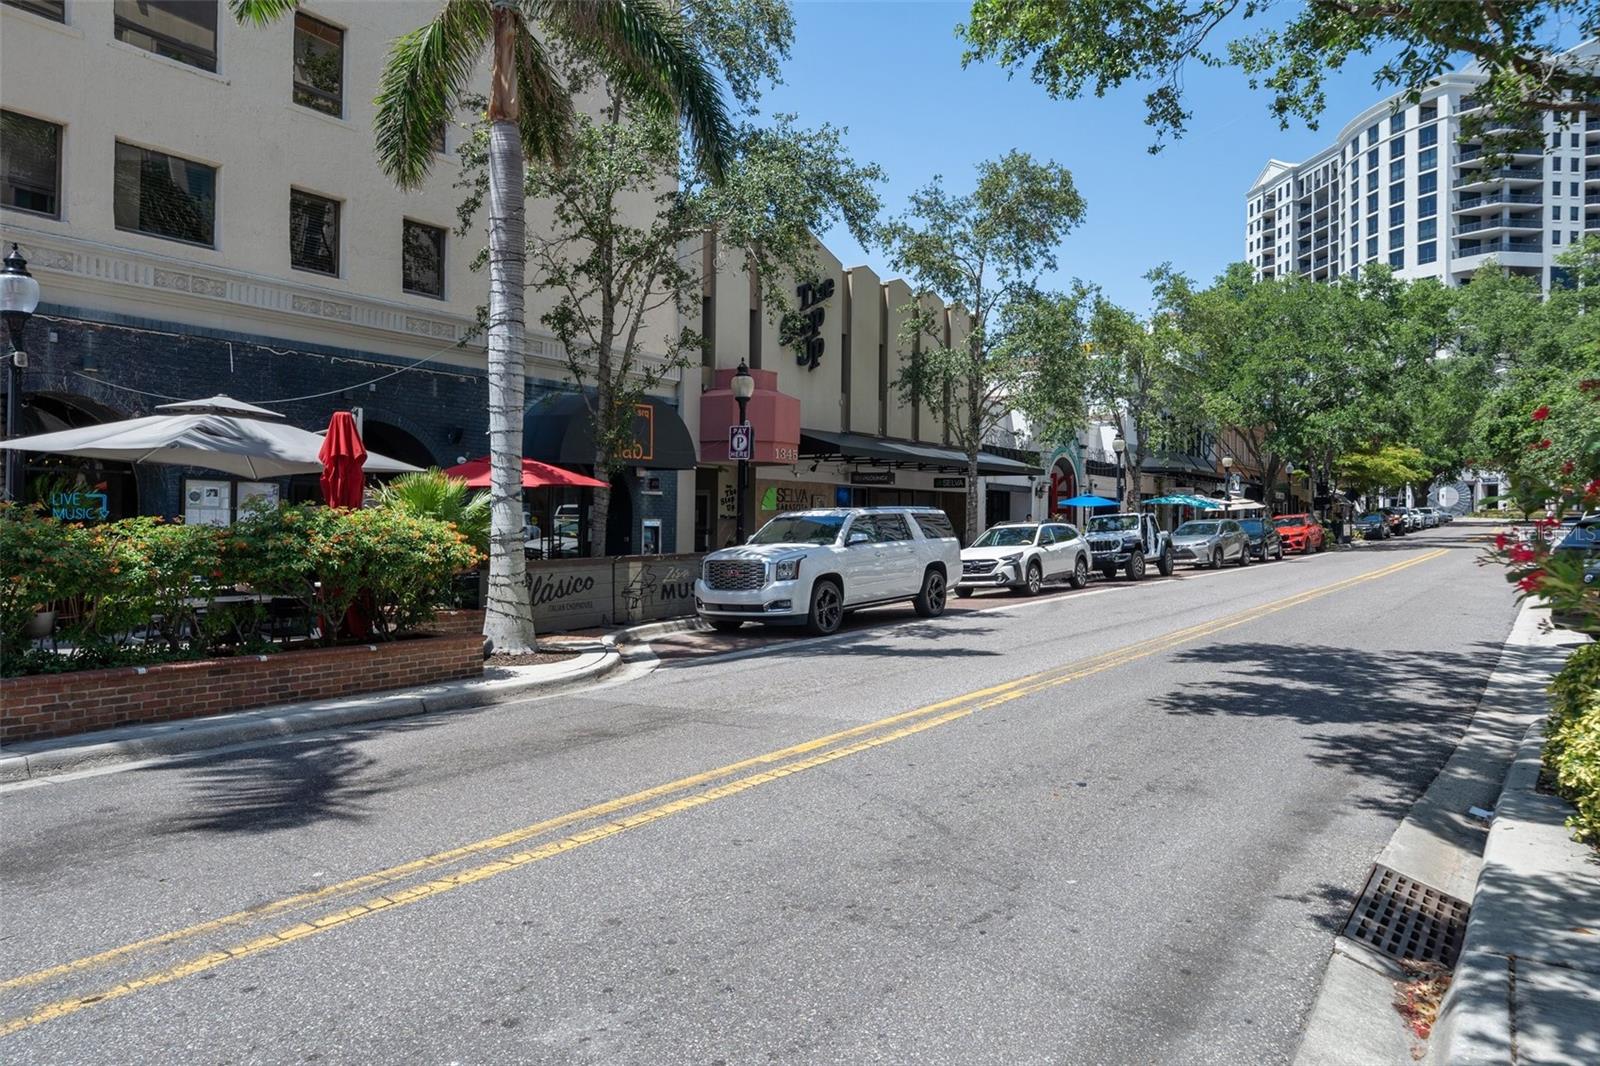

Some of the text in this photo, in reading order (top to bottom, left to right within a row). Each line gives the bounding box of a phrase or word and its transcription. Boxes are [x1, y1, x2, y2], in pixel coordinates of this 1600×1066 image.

[775, 448, 798, 461] 1345
[52, 492, 80, 506] LIVE
[776, 487, 808, 503] SELVA
[52, 507, 96, 520] MUSIC
